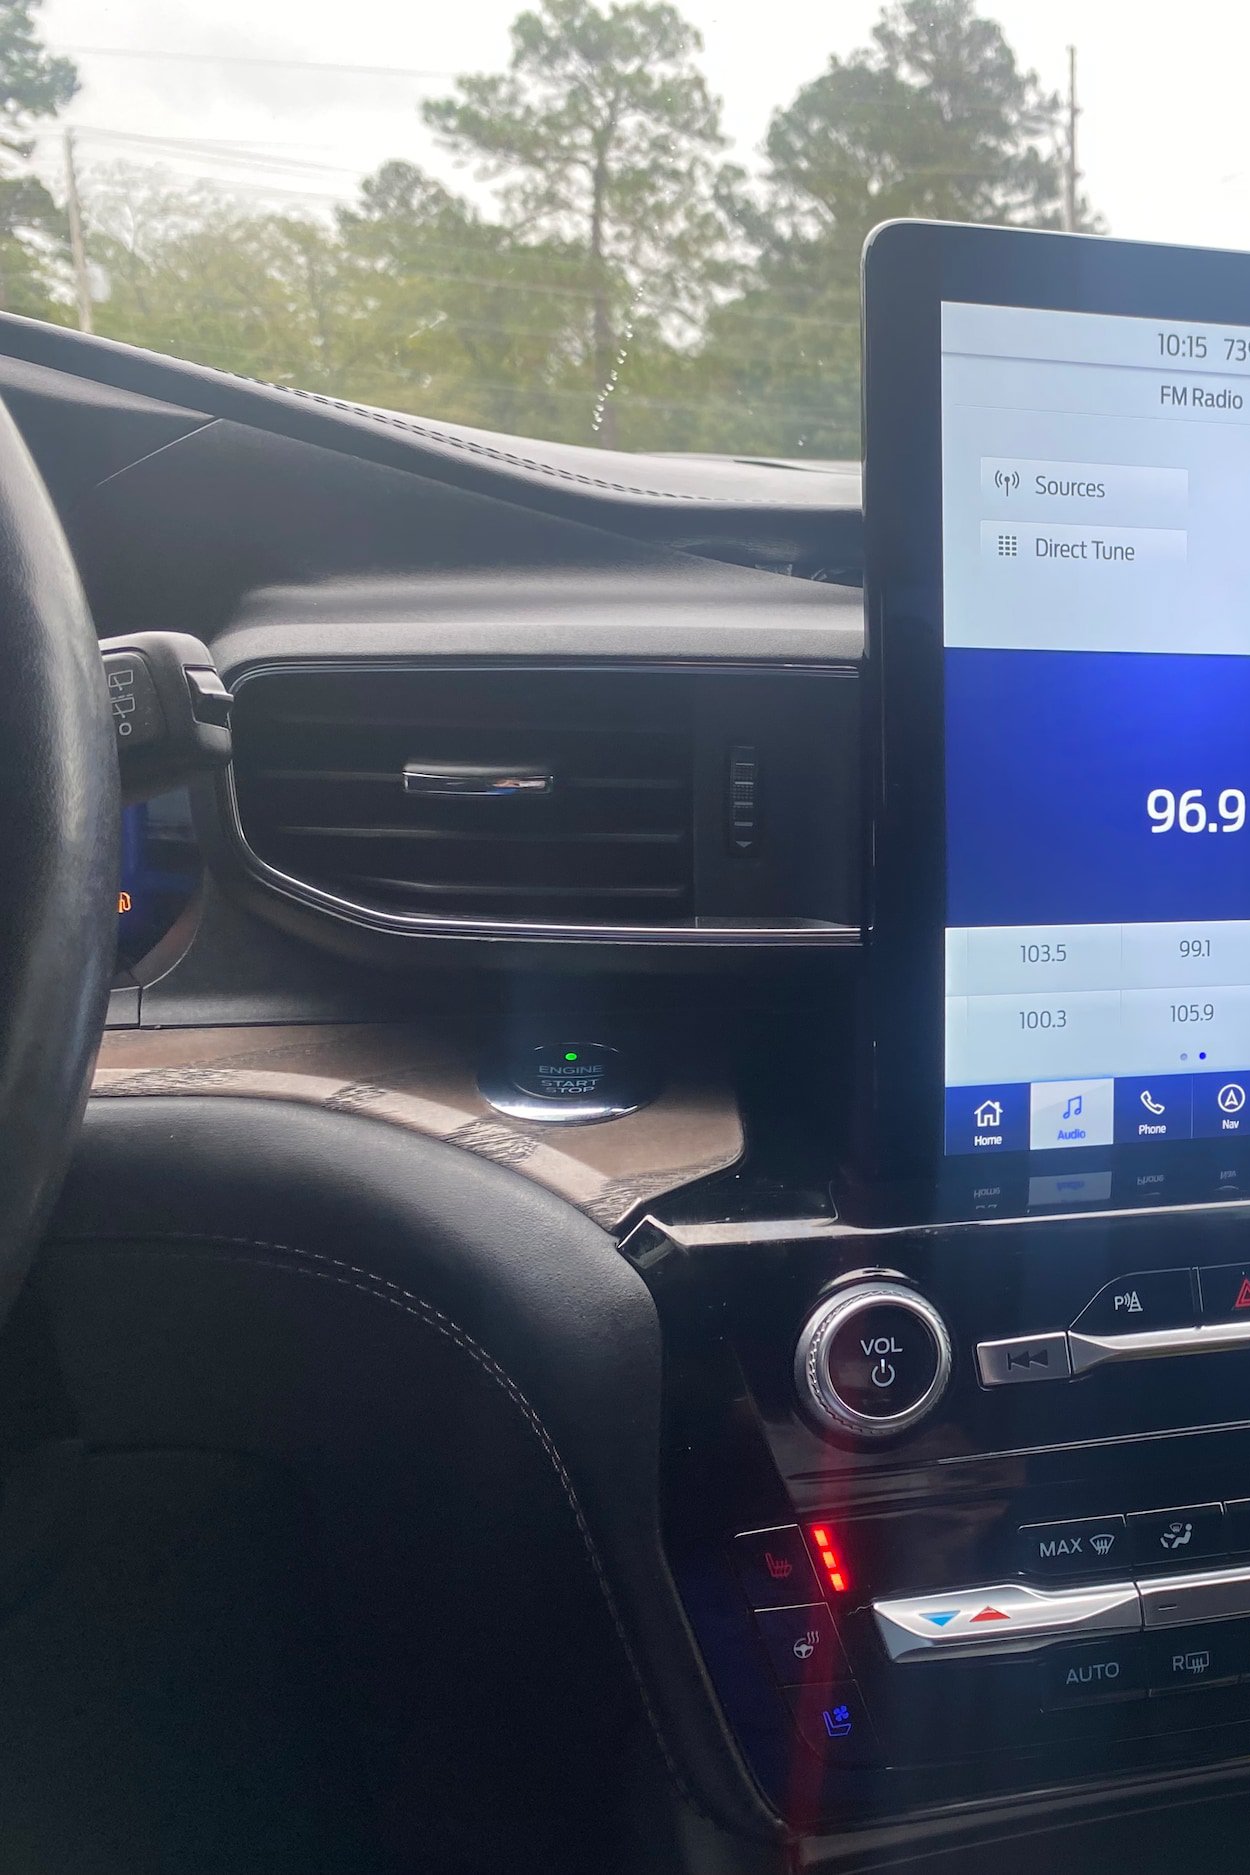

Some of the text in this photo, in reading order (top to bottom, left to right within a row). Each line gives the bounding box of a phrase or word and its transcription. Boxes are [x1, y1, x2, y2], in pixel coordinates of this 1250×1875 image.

[1157, 333, 1207, 359] 10:15
[1160, 385, 1244, 410] FM Radio
[1035, 475, 1106, 498] Sources
[1035, 537, 1135, 561] Direct Tune
[1146, 788, 1246, 834] 96.9
[1020, 944, 1067, 963] 103.5
[1179, 939, 1211, 958] 99.1
[1019, 1010, 1067, 1030] 100.3
[1170, 1003, 1215, 1023] 105.9
[538, 1065, 603, 1075] ENGINE
[541, 1078, 600, 1087] START
[545, 1086, 596, 1094] STOP
[1057, 1128, 1086, 1141] Audio
[1138, 1124, 1167, 1136] Phone
[1222, 1119, 1240, 1130] Nav
[974, 1135, 1003, 1147] Home
[860, 1336, 904, 1356] VOL
[1039, 1538, 1082, 1558] MAX
[1066, 1661, 1120, 1685] AUTO
